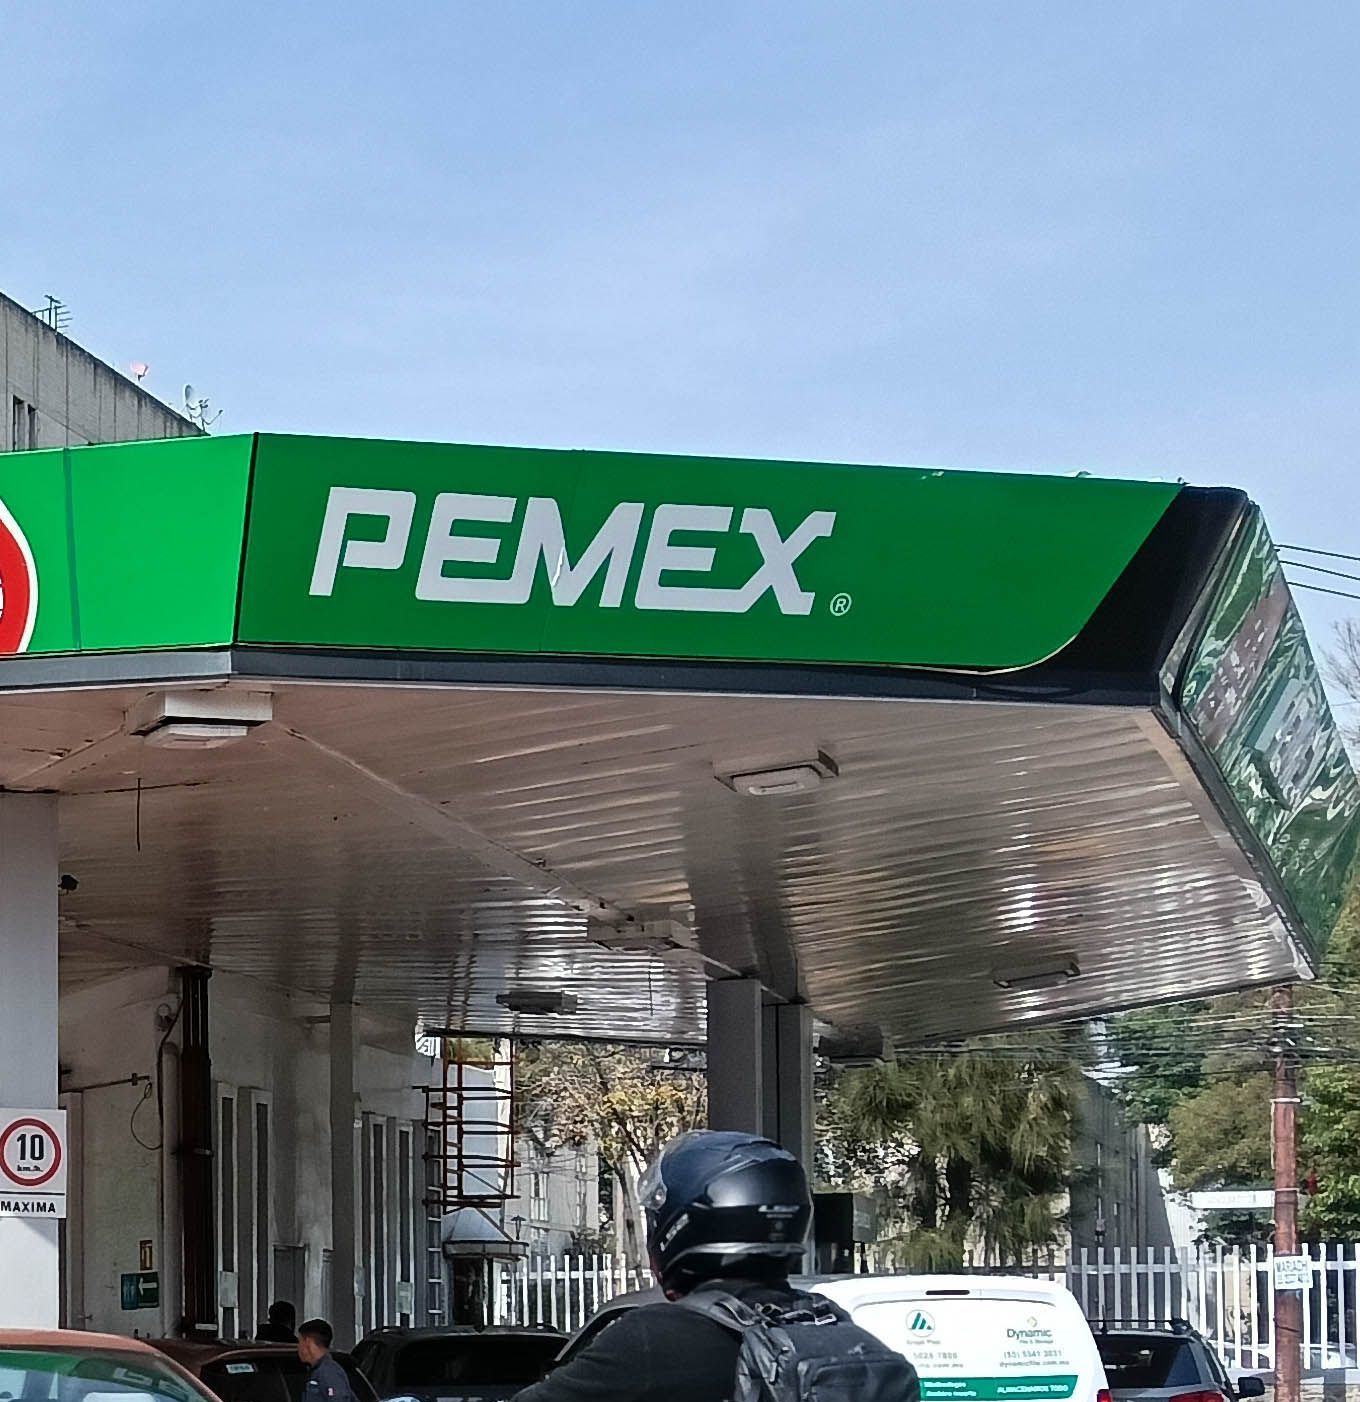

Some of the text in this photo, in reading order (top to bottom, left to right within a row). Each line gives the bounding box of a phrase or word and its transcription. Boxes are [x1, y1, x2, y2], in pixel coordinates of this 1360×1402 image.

[309, 486, 837, 616] PEMEX
[16, 1133, 44, 1161] 10
[0, 1200, 56, 1213] MAXIMA
[1006, 1328, 1053, 1340] Dynamic
